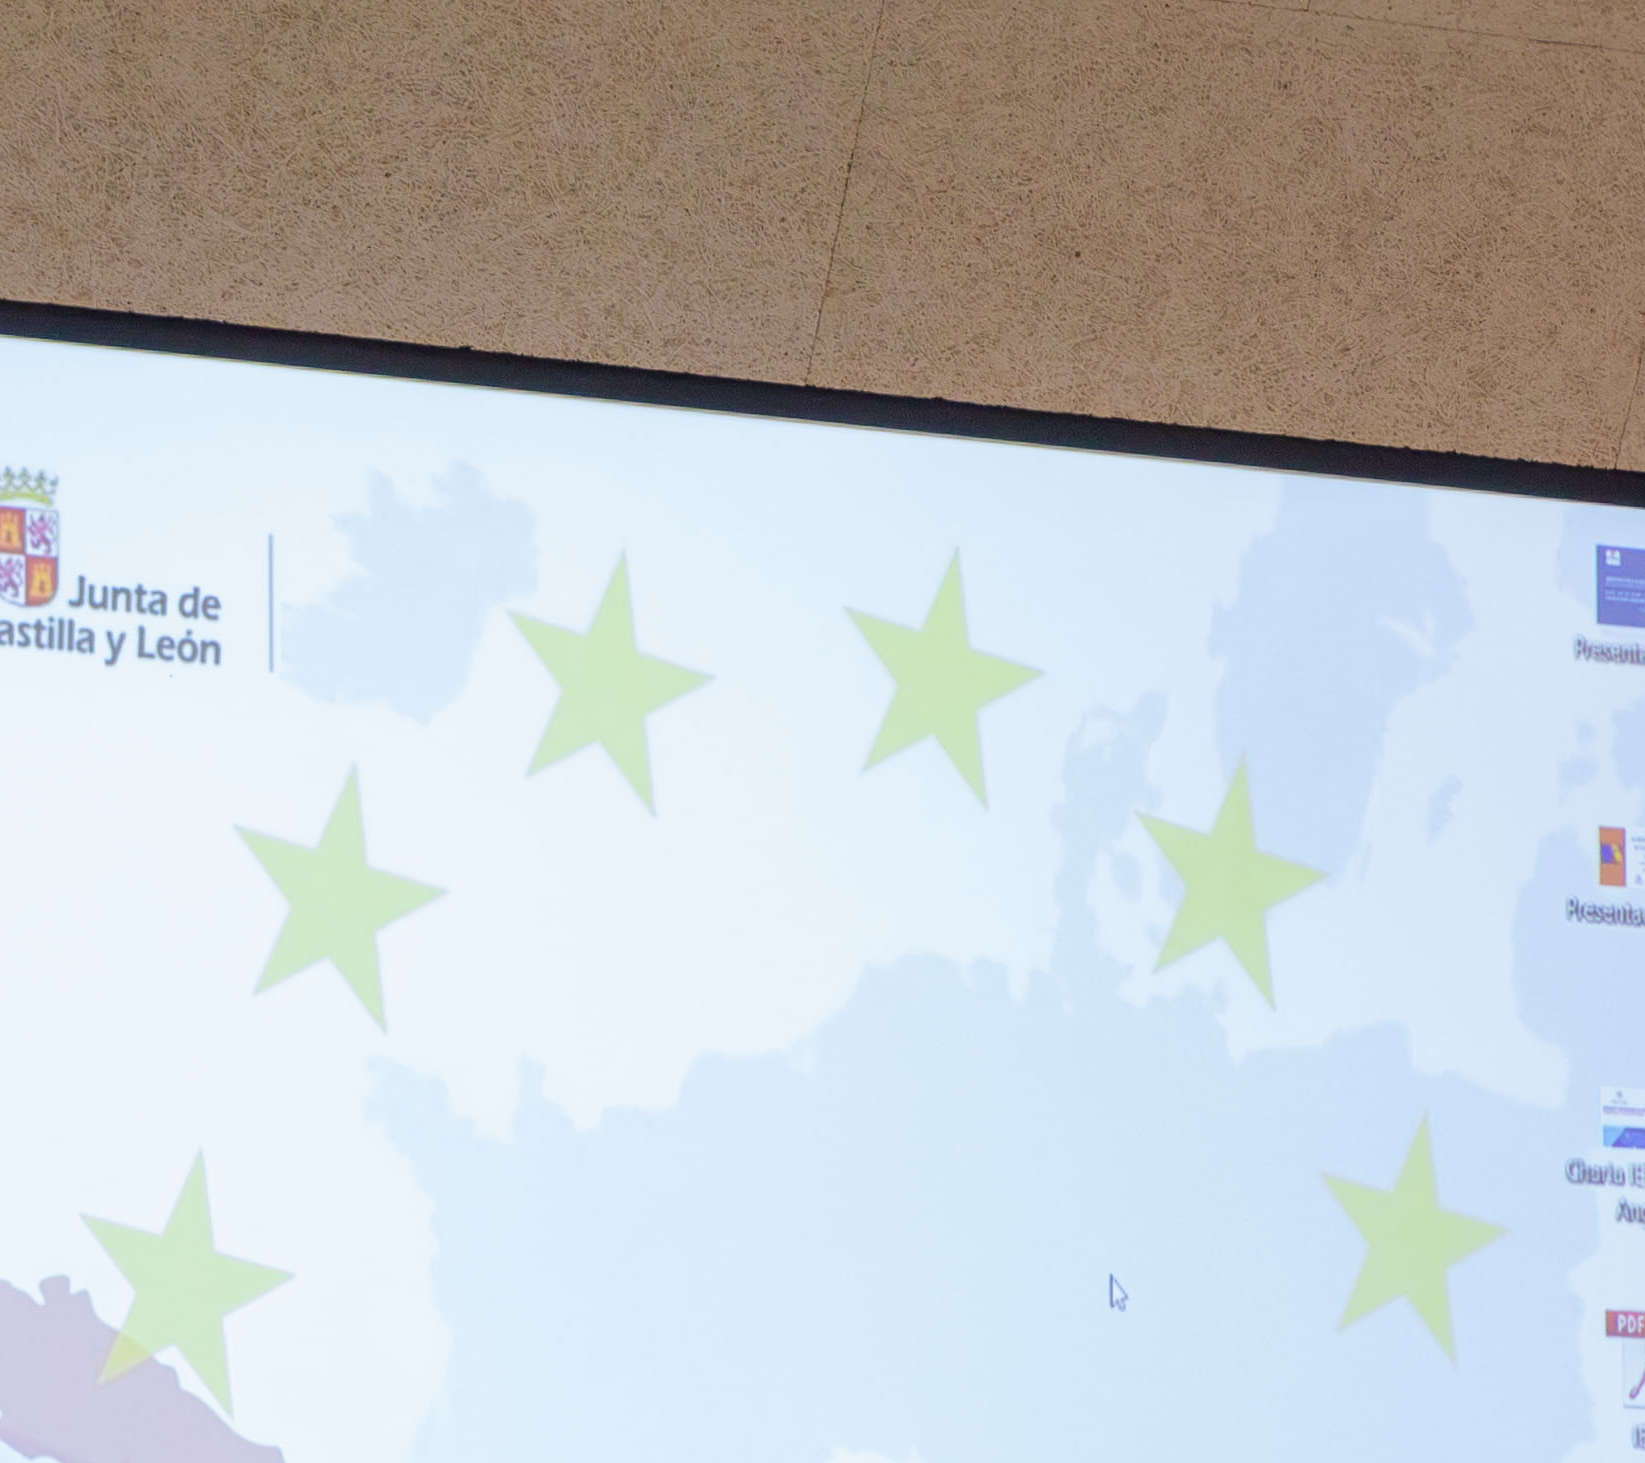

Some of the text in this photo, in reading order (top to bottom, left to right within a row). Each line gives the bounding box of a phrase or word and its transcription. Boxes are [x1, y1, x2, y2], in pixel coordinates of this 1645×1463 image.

[68, 574, 222, 622] Junta de
[104, 629, 127, 666] y
[136, 626, 222, 666] León
[1617, 1313, 1645, 1334] PDF
